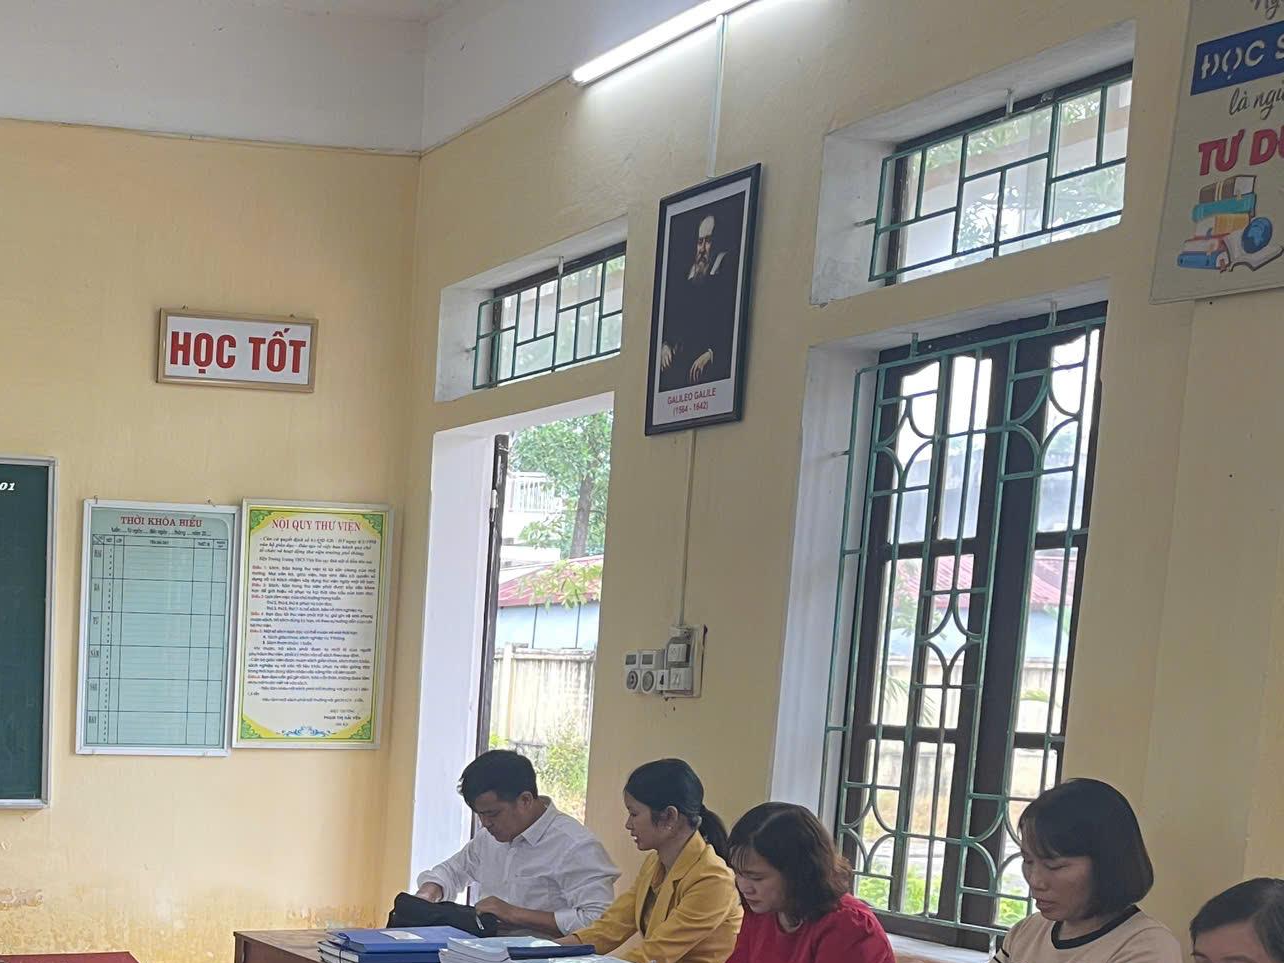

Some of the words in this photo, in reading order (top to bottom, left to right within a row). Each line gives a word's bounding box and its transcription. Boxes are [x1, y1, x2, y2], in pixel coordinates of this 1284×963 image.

[1201, 40, 1265, 80] ĐỌC
[1198, 129, 1245, 176] TƯ
[170, 331, 236, 374] HỌC
[248, 328, 306, 373] TỐT
[668, 392, 692, 404] GALILEO
[120, 515, 144, 525] THỜI
[272, 517, 289, 532] NỘI
[292, 520, 315, 533] QUY
[316, 520, 336, 531] THƯ
[338, 518, 361, 534] VIỆN
